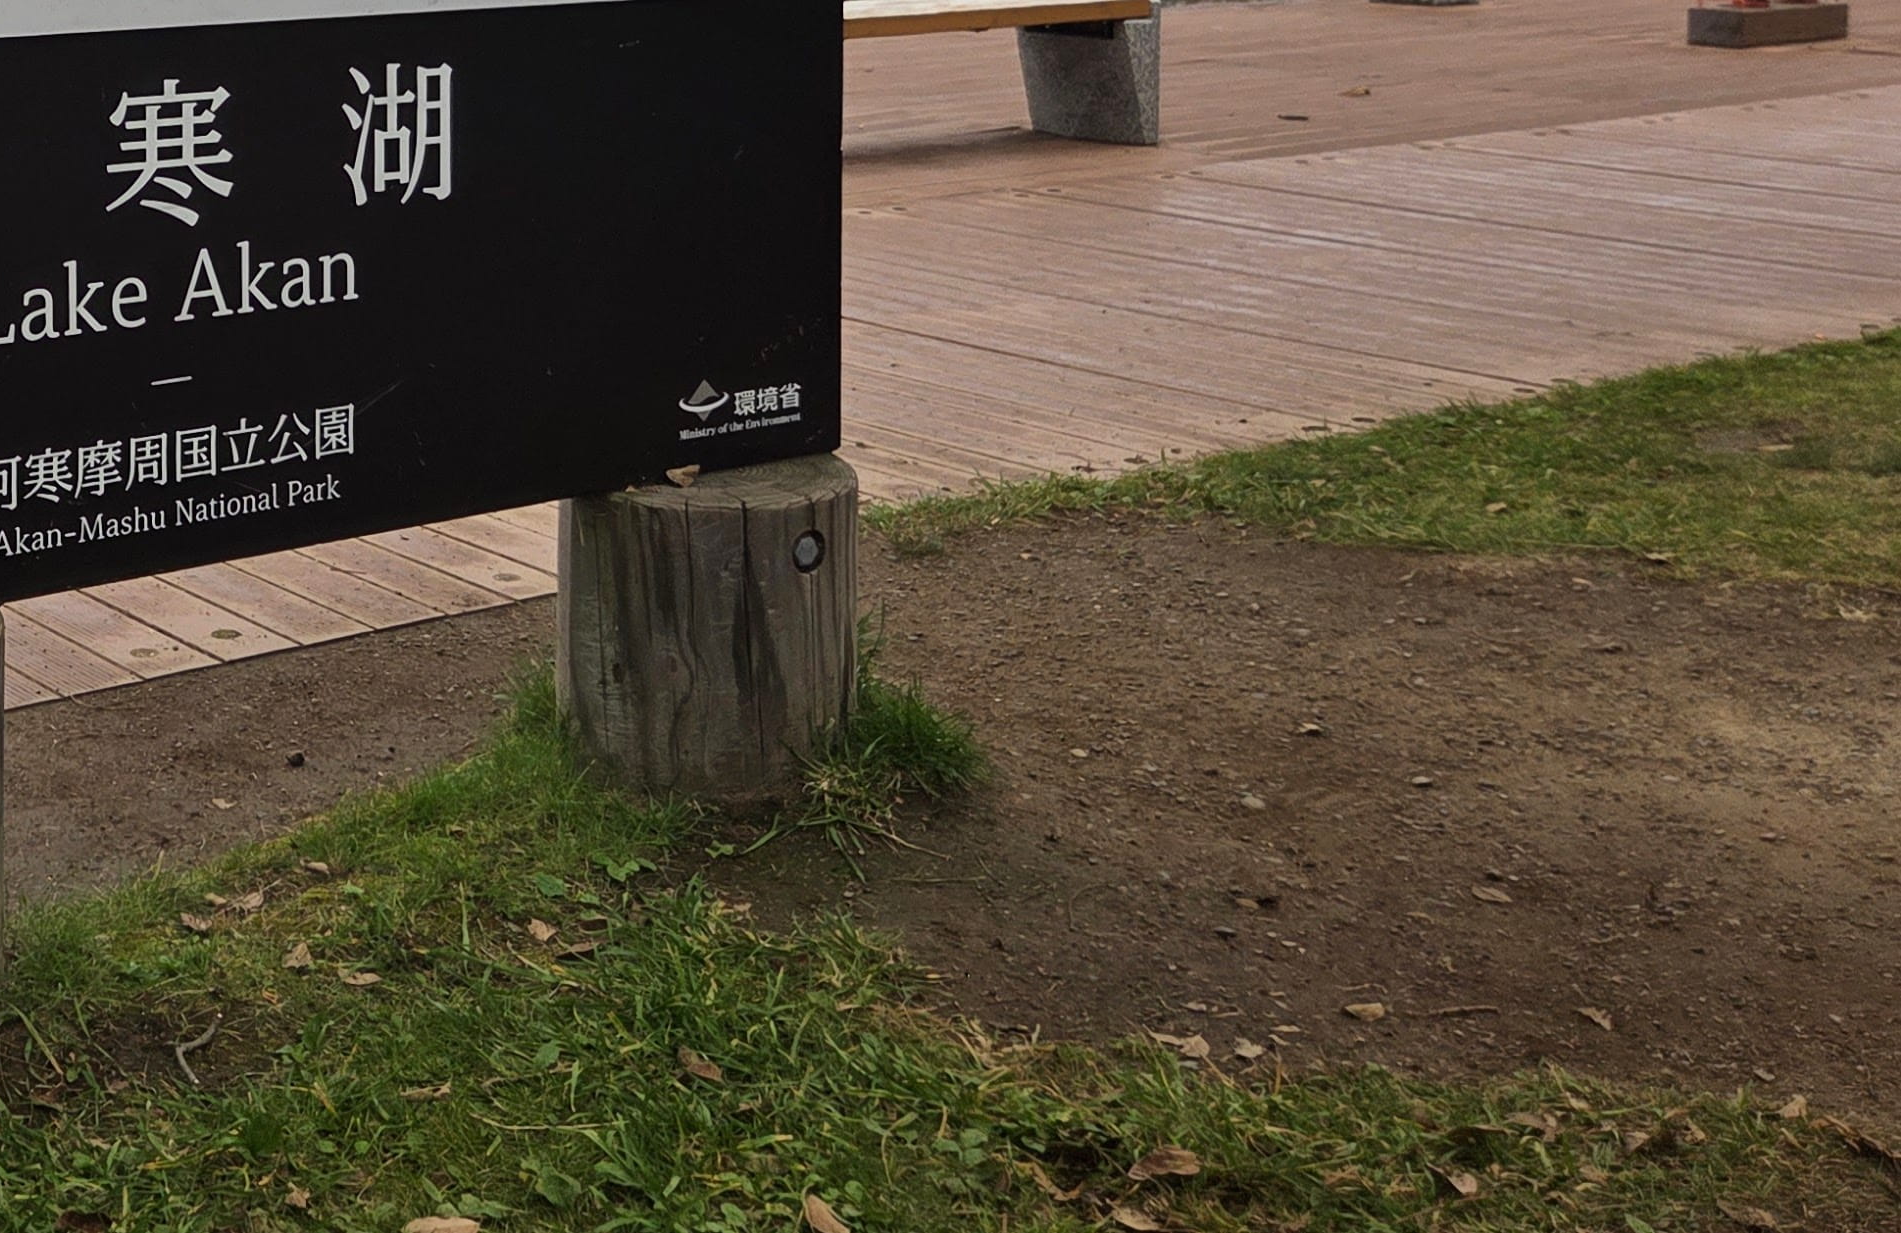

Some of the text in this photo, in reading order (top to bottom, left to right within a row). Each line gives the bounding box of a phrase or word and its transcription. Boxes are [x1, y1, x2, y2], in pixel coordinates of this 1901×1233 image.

[173, 240, 360, 322] Akan
[733, 382, 802, 416] 環境省
[678, 412, 801, 441] Ministry of the Environment
[175, 482, 280, 527] National
[287, 473, 341, 507] Park
